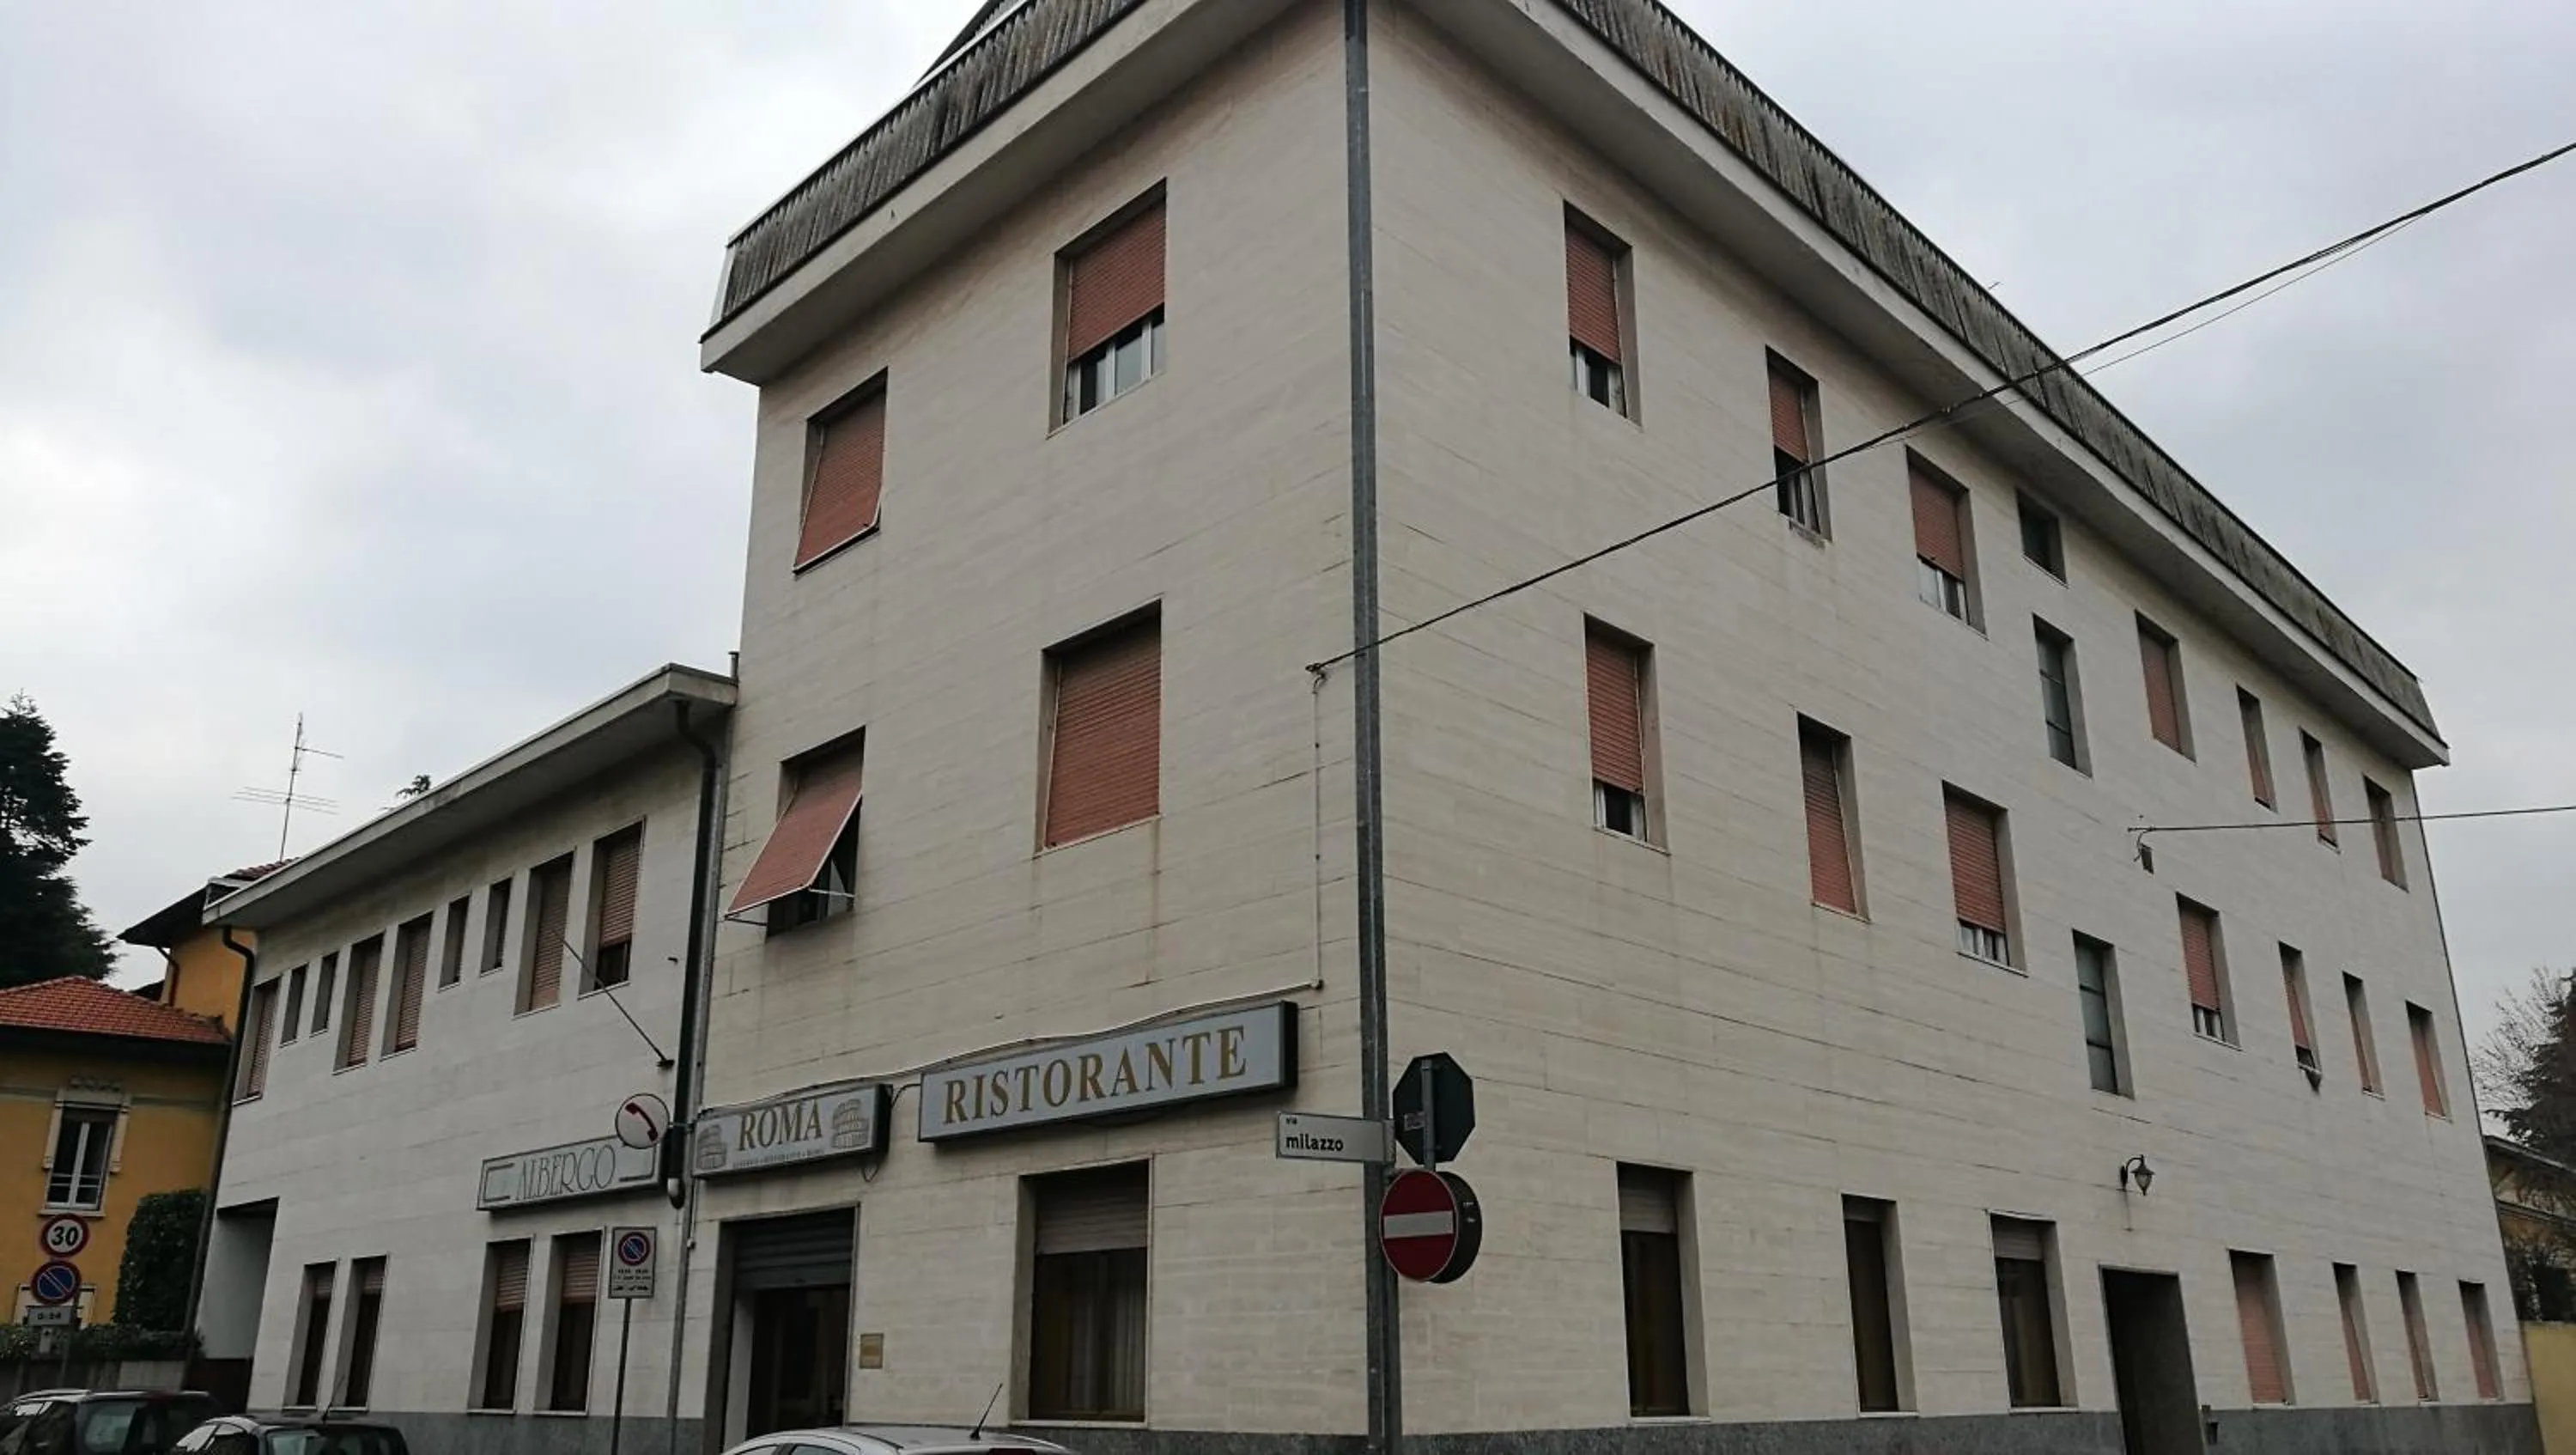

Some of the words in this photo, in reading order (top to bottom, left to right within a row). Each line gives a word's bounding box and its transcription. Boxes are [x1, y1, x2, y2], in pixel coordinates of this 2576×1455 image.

[943, 1025, 1247, 1124] RISTORANTE
[738, 1099, 823, 1151] ROMA
[1285, 1134, 1344, 1152] milazzo
[516, 1144, 616, 1201] ALBERGO
[52, 1226, 78, 1245] 30
